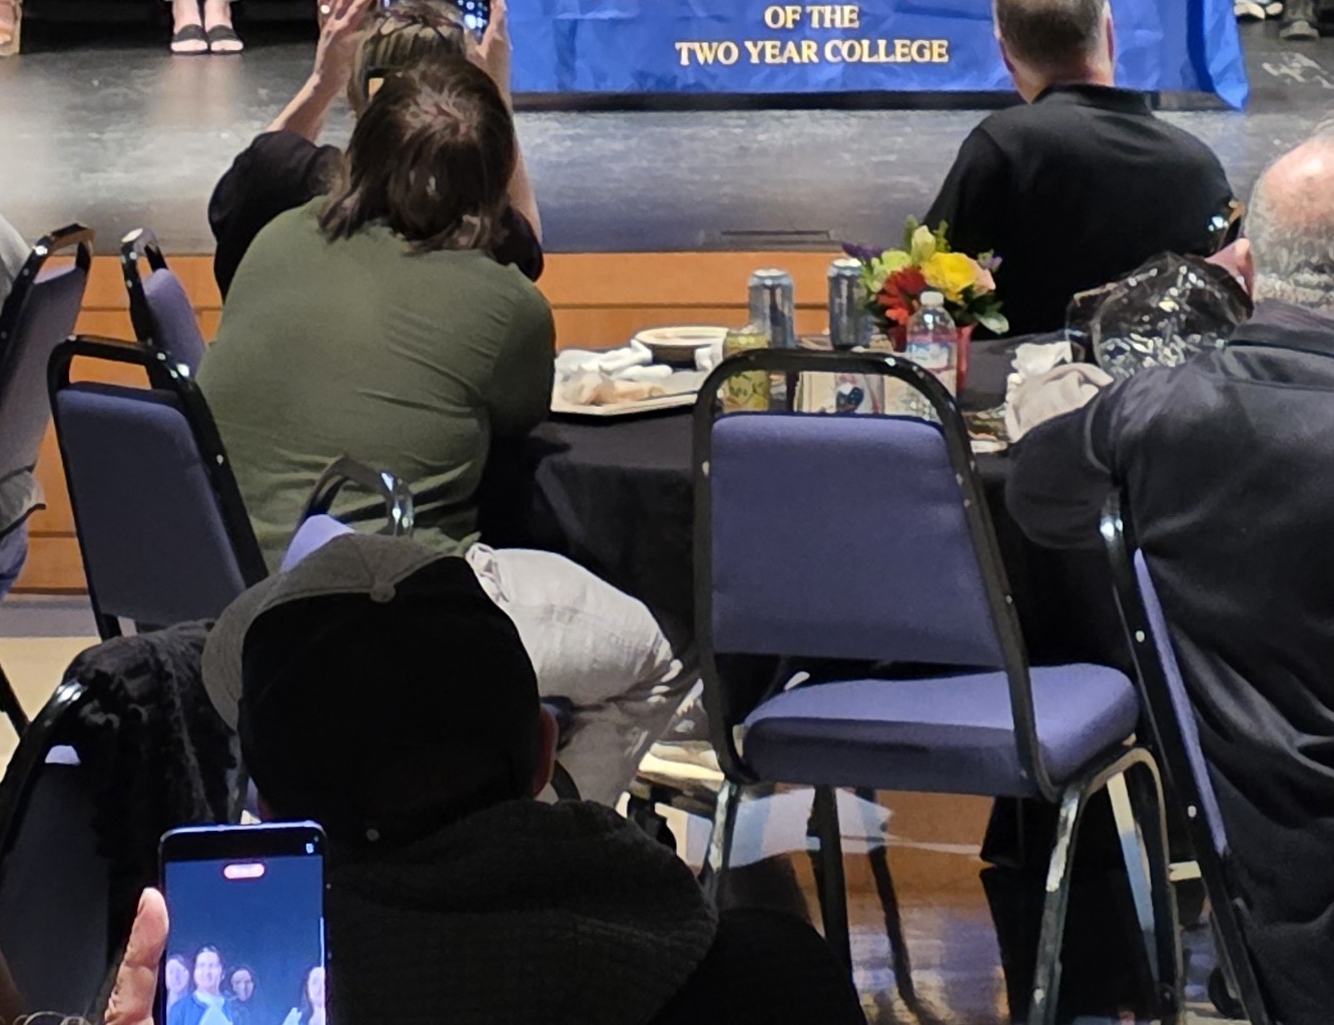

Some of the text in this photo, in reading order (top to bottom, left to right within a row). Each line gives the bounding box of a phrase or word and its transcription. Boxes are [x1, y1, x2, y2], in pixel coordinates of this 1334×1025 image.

[764, 5, 860, 29] OF THE
[675, 39, 949, 66] TWO YEAR COLLEGE
